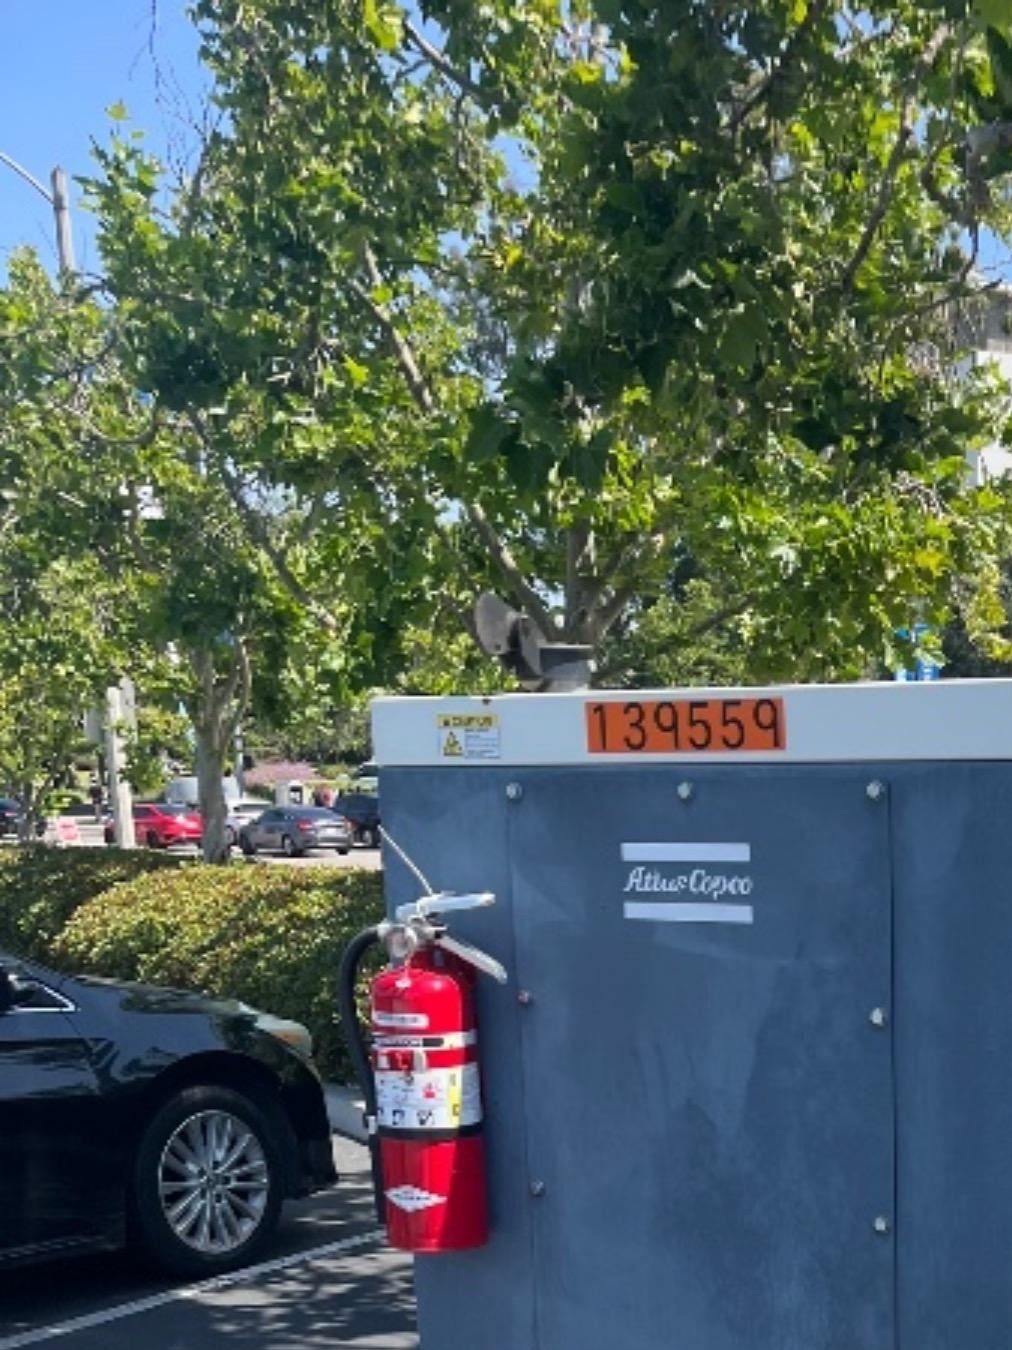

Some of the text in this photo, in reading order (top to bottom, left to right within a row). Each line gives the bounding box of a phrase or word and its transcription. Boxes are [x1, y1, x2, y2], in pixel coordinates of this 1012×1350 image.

[592, 698, 780, 751] 139559
[623, 865, 754, 901] Atlas Copco
